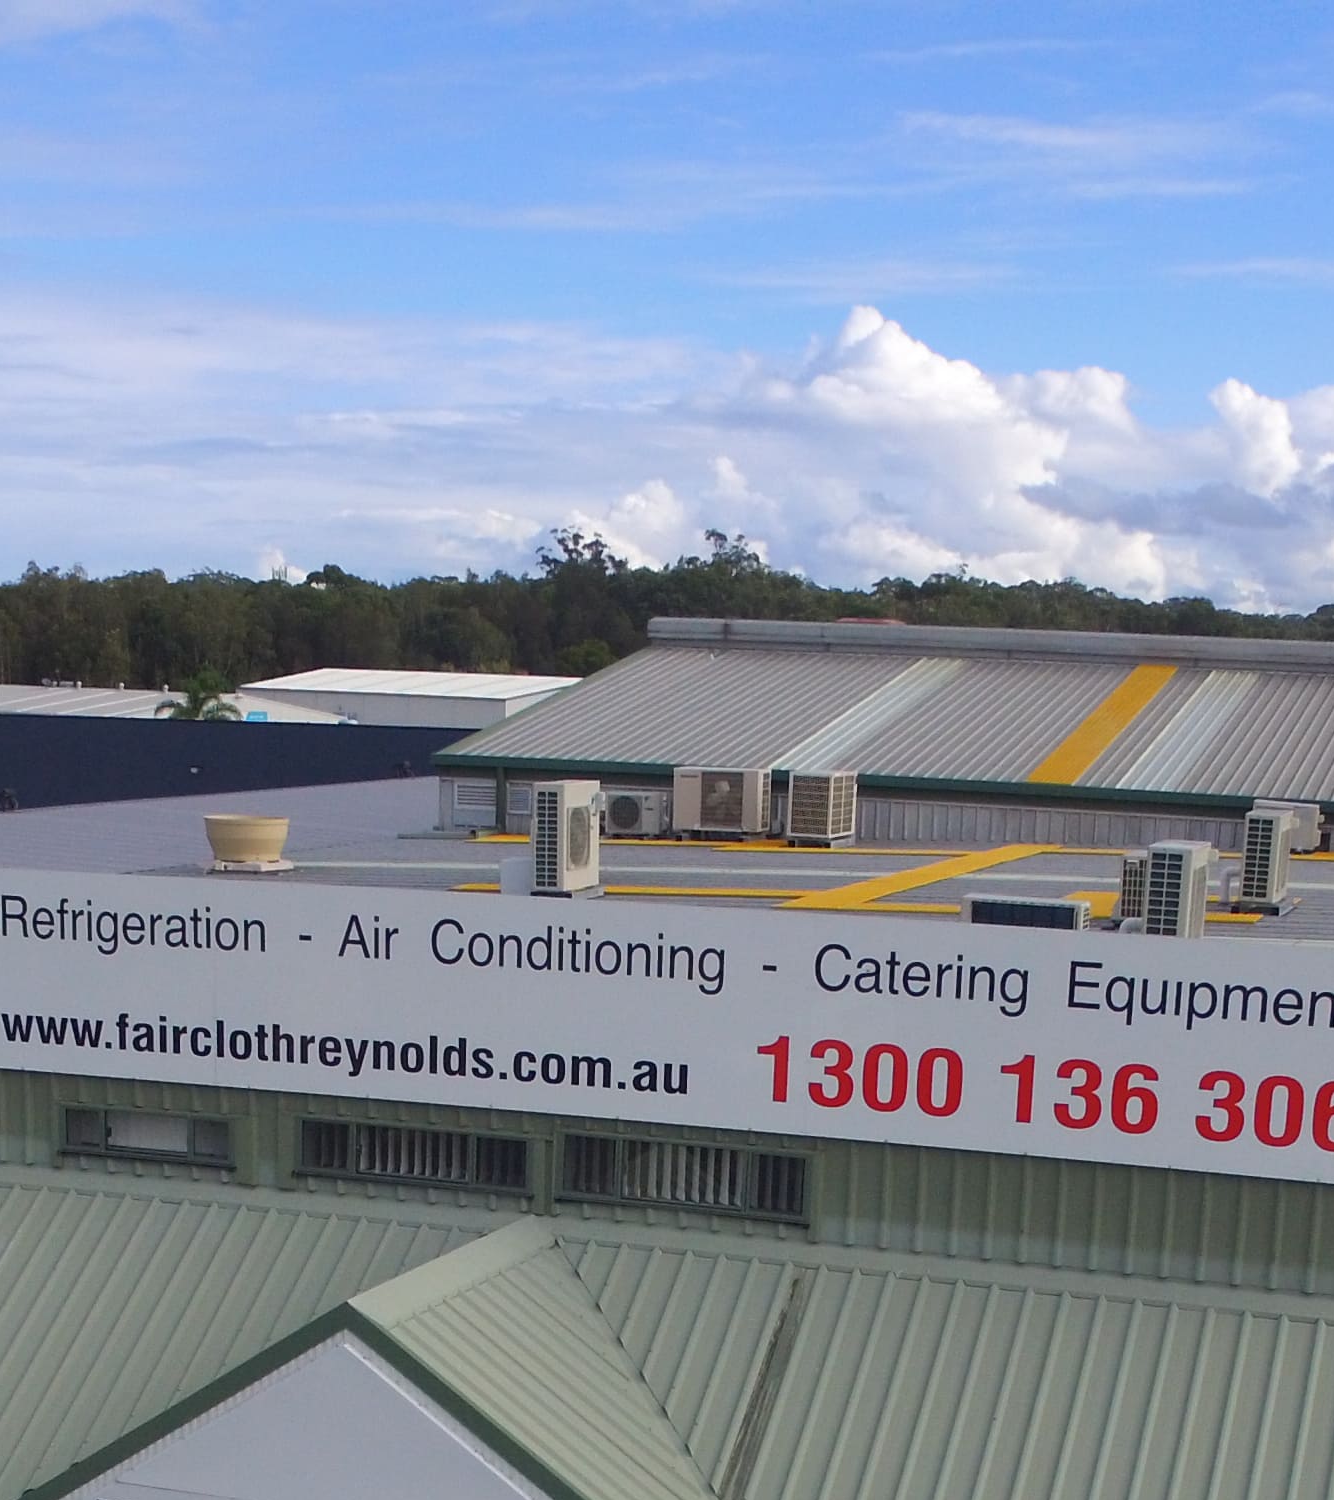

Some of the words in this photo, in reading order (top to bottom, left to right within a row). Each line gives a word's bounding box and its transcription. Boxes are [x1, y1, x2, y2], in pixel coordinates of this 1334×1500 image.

[0, 894, 267, 956] Refrigeration
[339, 914, 399, 960] Air
[430, 918, 727, 995] Conditioning
[813, 942, 1030, 1017] Catering
[1, 1011, 689, 1096] www.fairclothreynolds.com.au
[757, 1034, 964, 1118] 1300
[1000, 1054, 1160, 1135] 136
